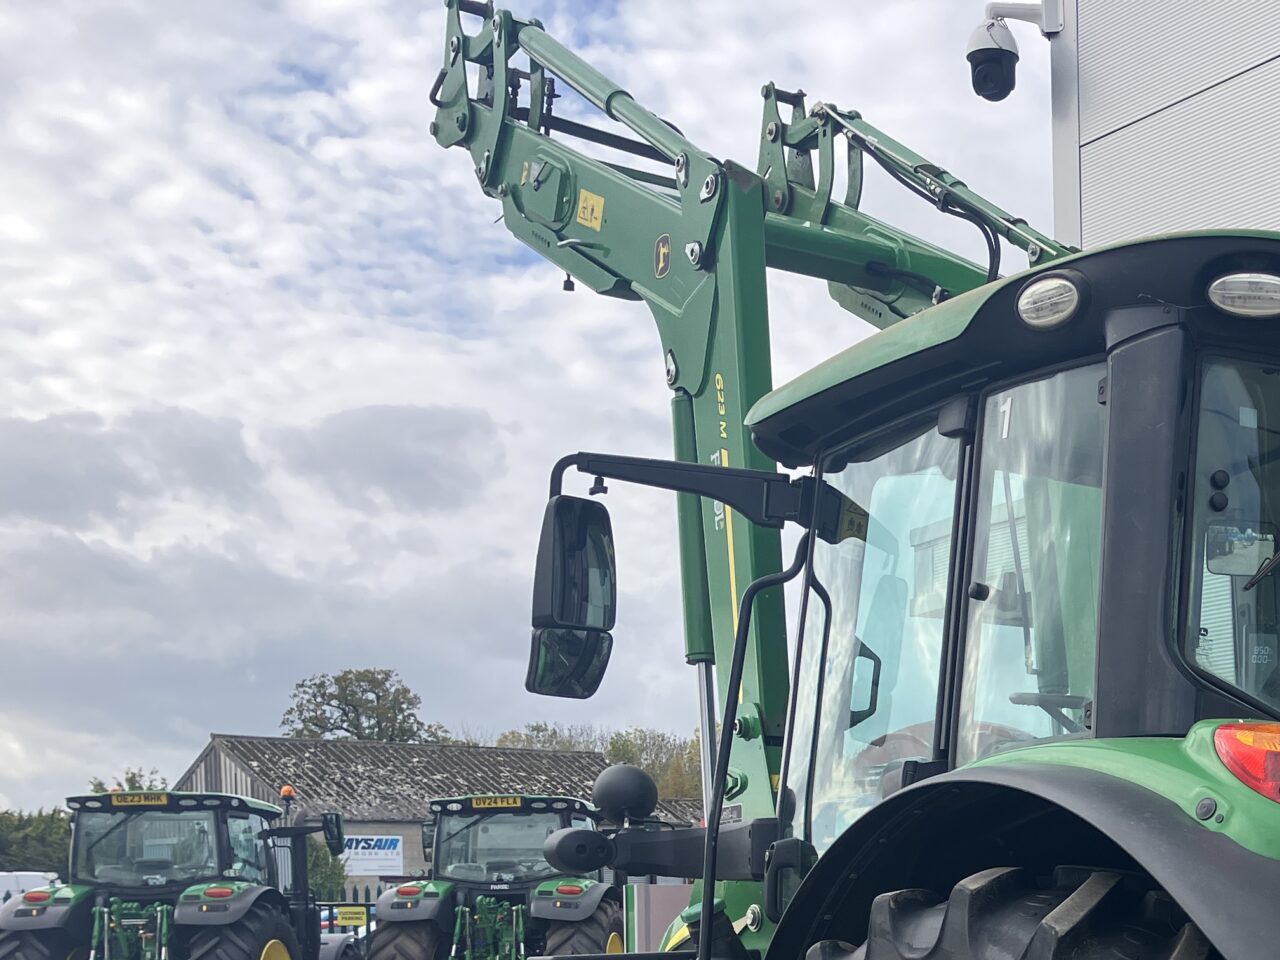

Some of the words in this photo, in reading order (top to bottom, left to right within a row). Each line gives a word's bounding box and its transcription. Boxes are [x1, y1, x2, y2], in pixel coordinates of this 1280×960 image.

[715, 373, 726, 416] 623
[720, 421, 728, 438] M
[1000, 397, 1013, 439] 1
[710, 449, 725, 531] FOL
[343, 838, 400, 850] AYSAIR
